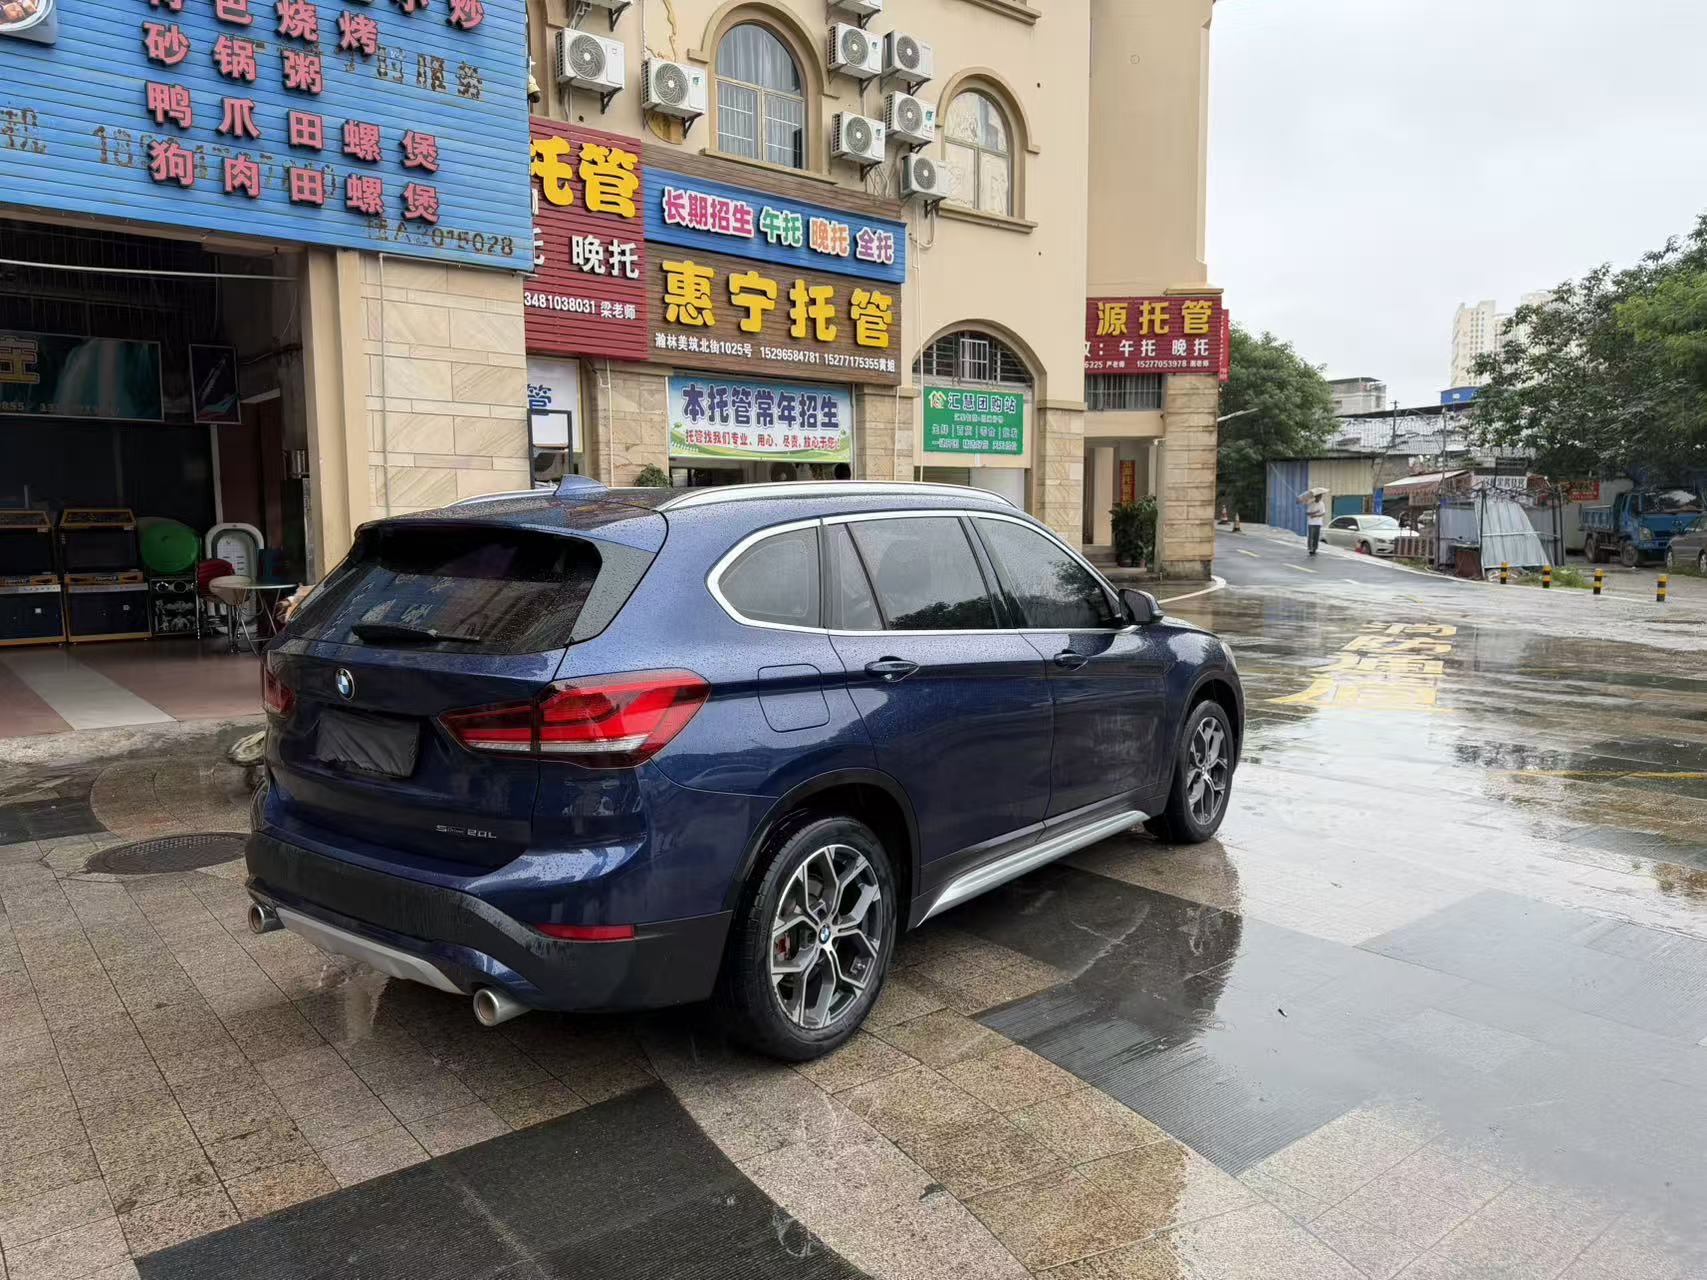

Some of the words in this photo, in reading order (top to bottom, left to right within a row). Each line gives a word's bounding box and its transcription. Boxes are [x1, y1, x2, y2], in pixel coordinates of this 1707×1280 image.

[142, 20, 322, 94] 砂锅粥
[146, 80, 440, 172] 鸭爪田螺煲
[150, 140, 440, 223] 狗肉田螺煲
[530, 135, 639, 218] 托管
[662, 187, 754, 238] 长期招生
[760, 206, 802, 247] 午托
[809, 217, 849, 257] 晚托
[856, 226, 894, 265] 全托
[571, 235, 640, 279] 晚托
[524, 292, 596, 314] 3481038031
[600, 301, 636, 320] 梁老师
[662, 261, 893, 348] 惠宁托管
[1096, 300, 1213, 336] 源托管
[760, 346, 820, 364] 15296584781
[1119, 339, 1156, 357] 午托
[1171, 338, 1209, 357] 晚托
[682, 383, 840, 429] 本托管常年招生
[948, 391, 1016, 414] 汇慧团购站
